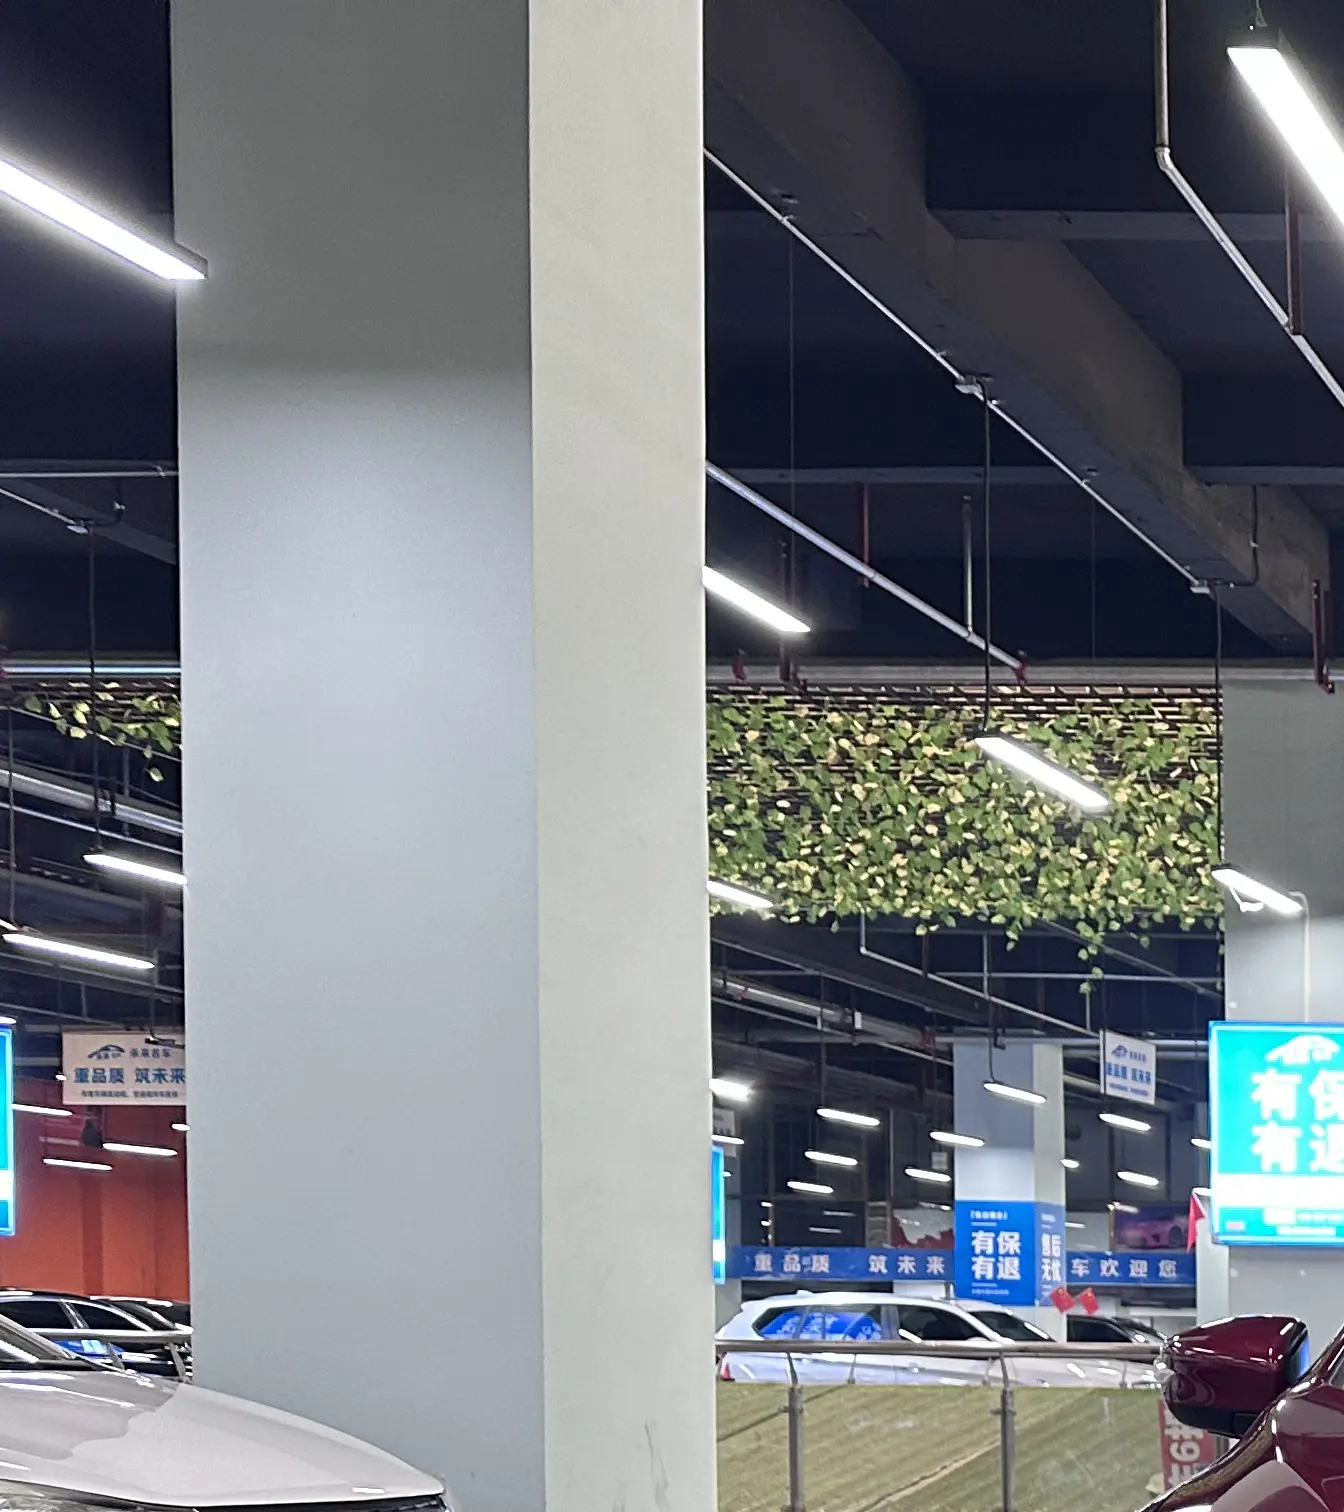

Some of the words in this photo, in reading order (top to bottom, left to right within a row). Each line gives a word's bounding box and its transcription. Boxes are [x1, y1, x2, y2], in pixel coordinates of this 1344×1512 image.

[74, 1067, 125, 1084] 重品质
[135, 1067, 186, 1084] 筑未来
[970, 1230, 1022, 1255] 有保
[753, 1252, 831, 1274] 重品质
[867, 1254, 945, 1275] 筑未来
[970, 1256, 1022, 1281] 有退
